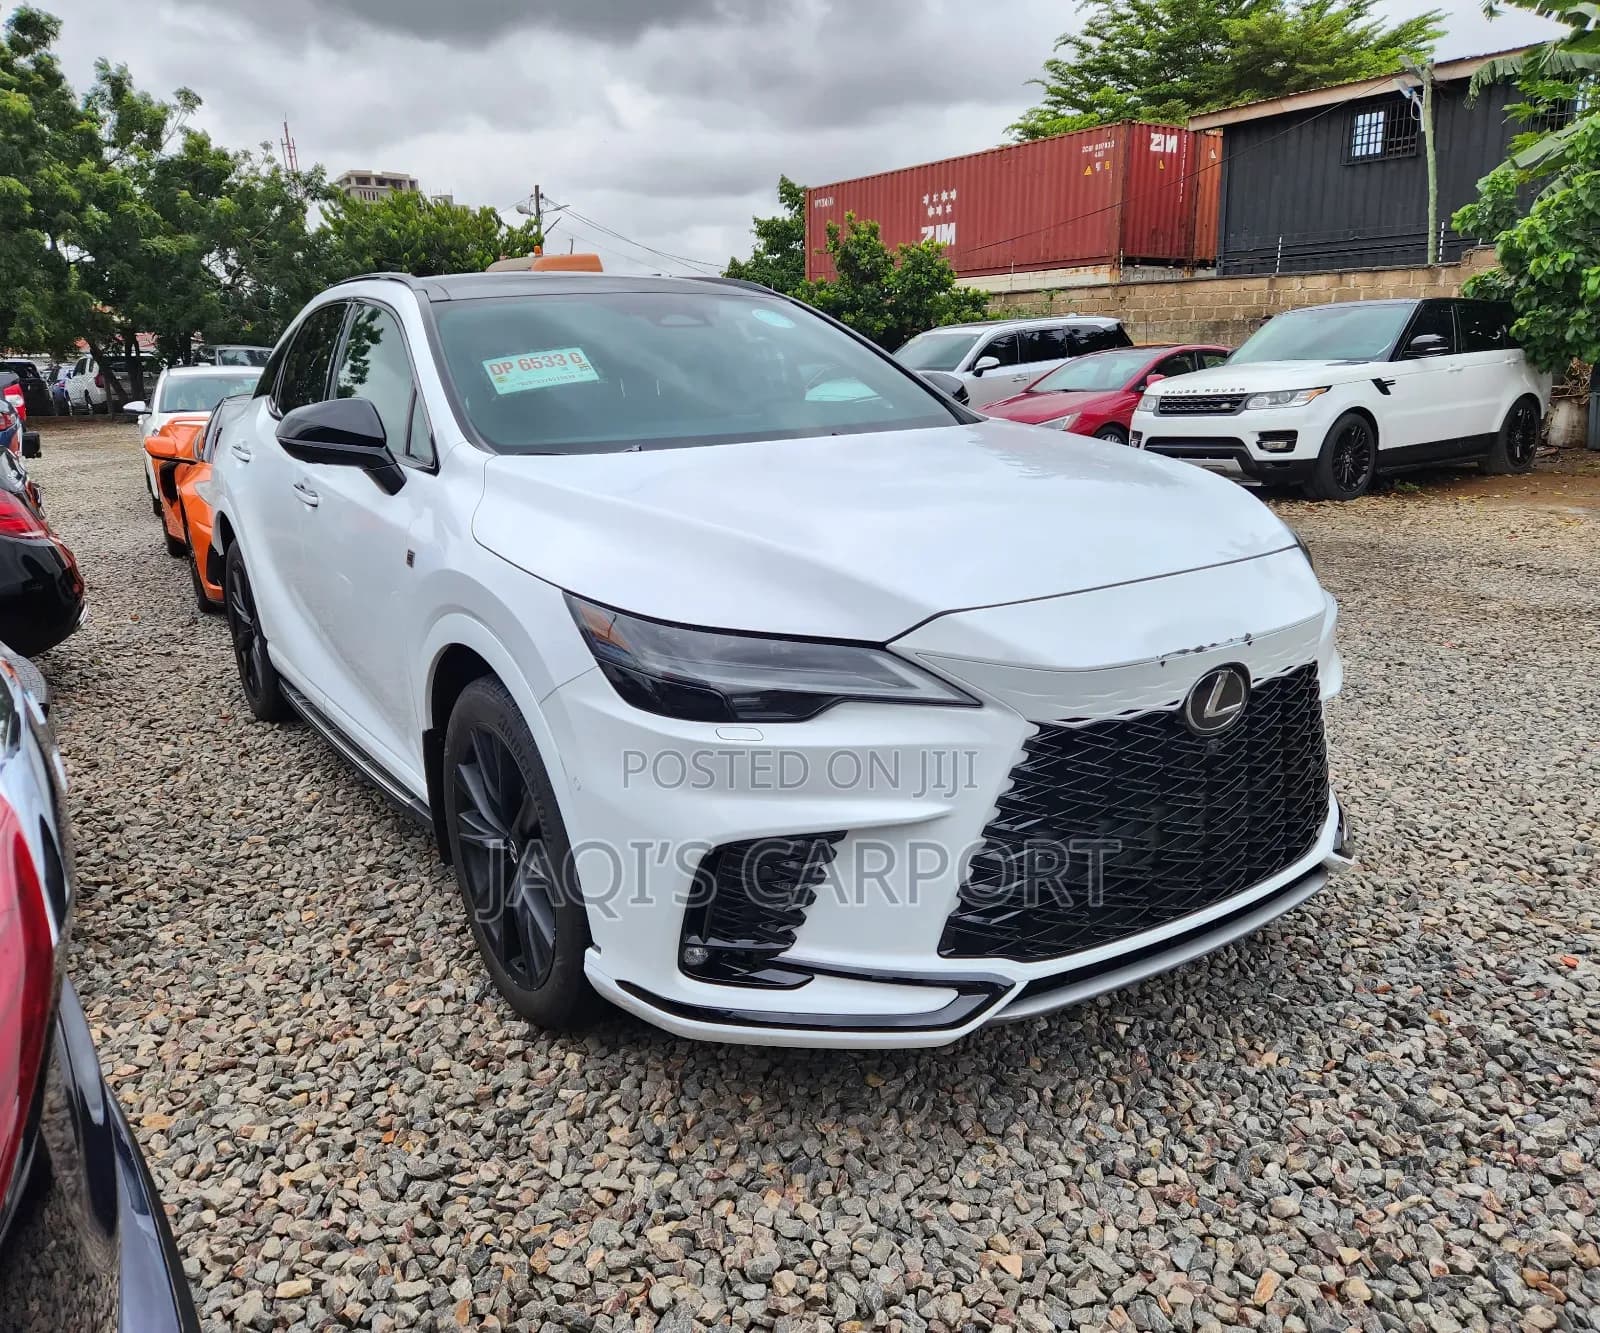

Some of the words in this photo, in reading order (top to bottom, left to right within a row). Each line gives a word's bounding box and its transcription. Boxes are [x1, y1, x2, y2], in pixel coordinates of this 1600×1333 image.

[1150, 132, 1178, 154] ZIM
[920, 223, 956, 246] ZIM
[489, 361, 514, 376] DP
[518, 353, 567, 372] 6533
[568, 352, 583, 365] G
